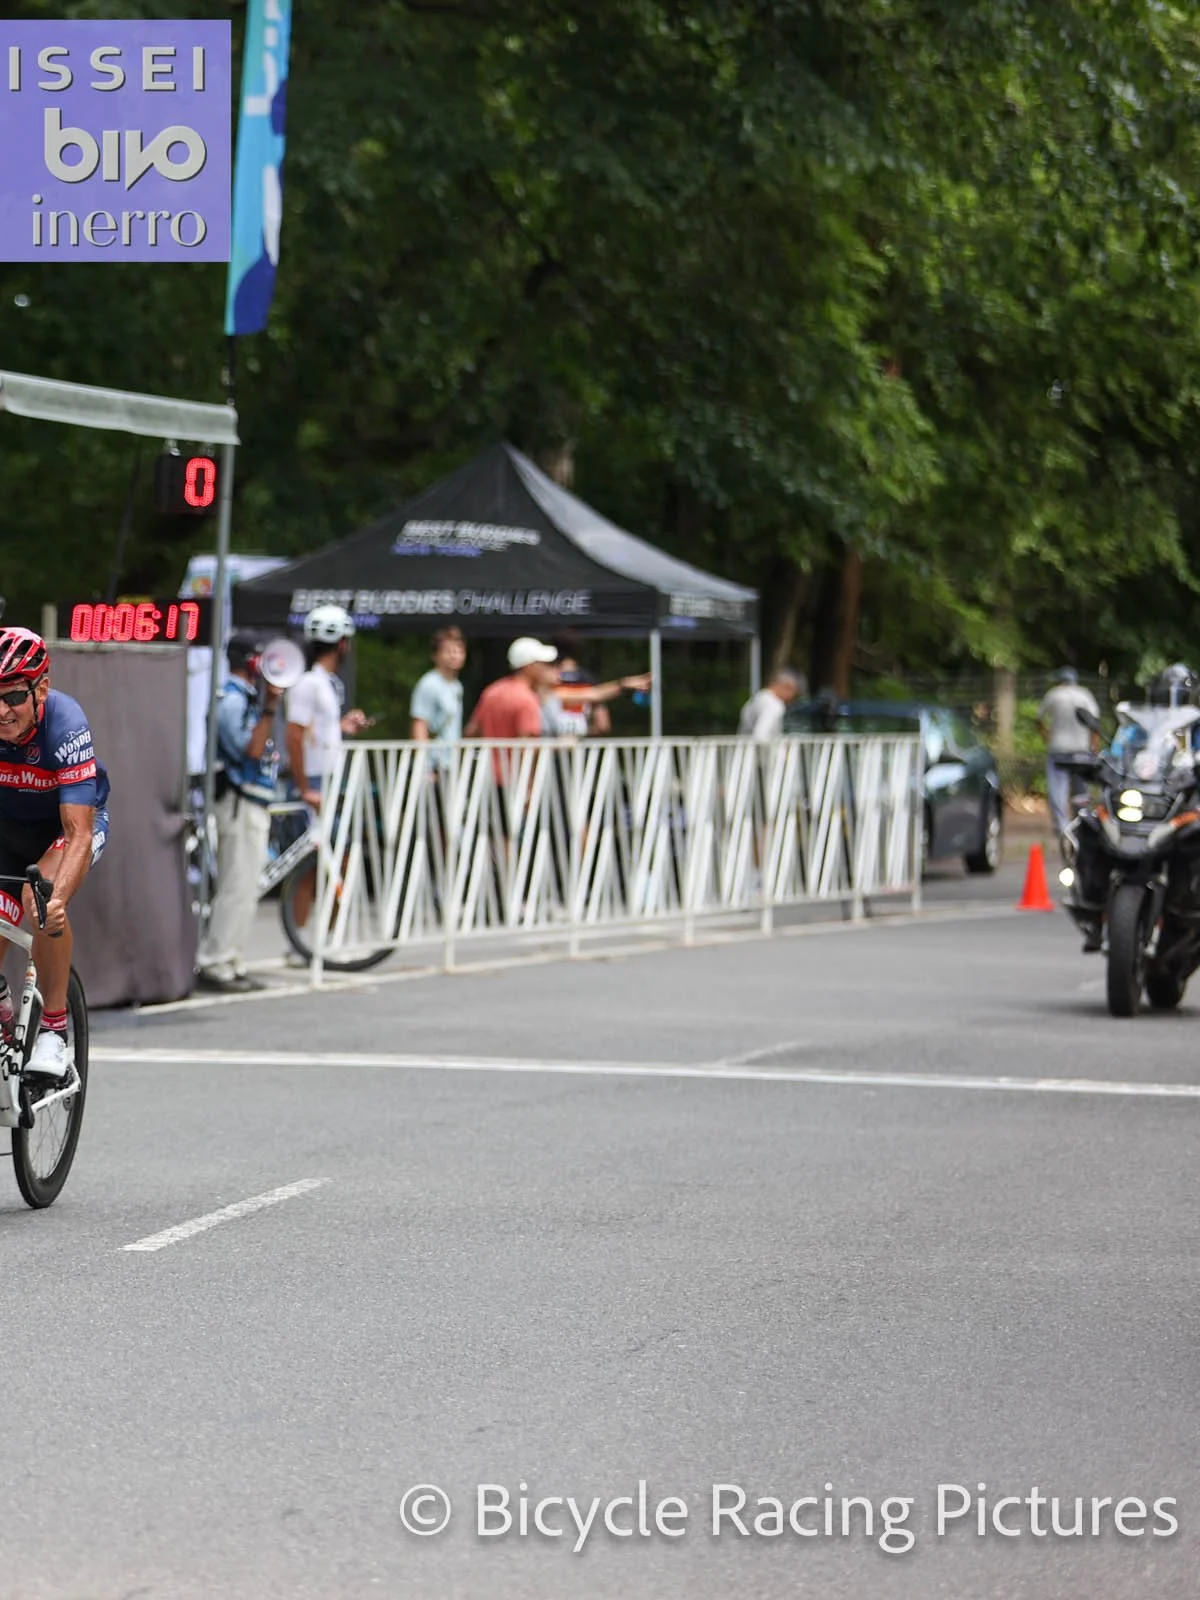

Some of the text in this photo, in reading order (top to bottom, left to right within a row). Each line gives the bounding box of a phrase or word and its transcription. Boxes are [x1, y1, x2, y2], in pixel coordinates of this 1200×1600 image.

[184, 457, 216, 507] 0
[455, 588, 592, 616] CHALLENGE
[21, 770, 59, 788] WHEEL
